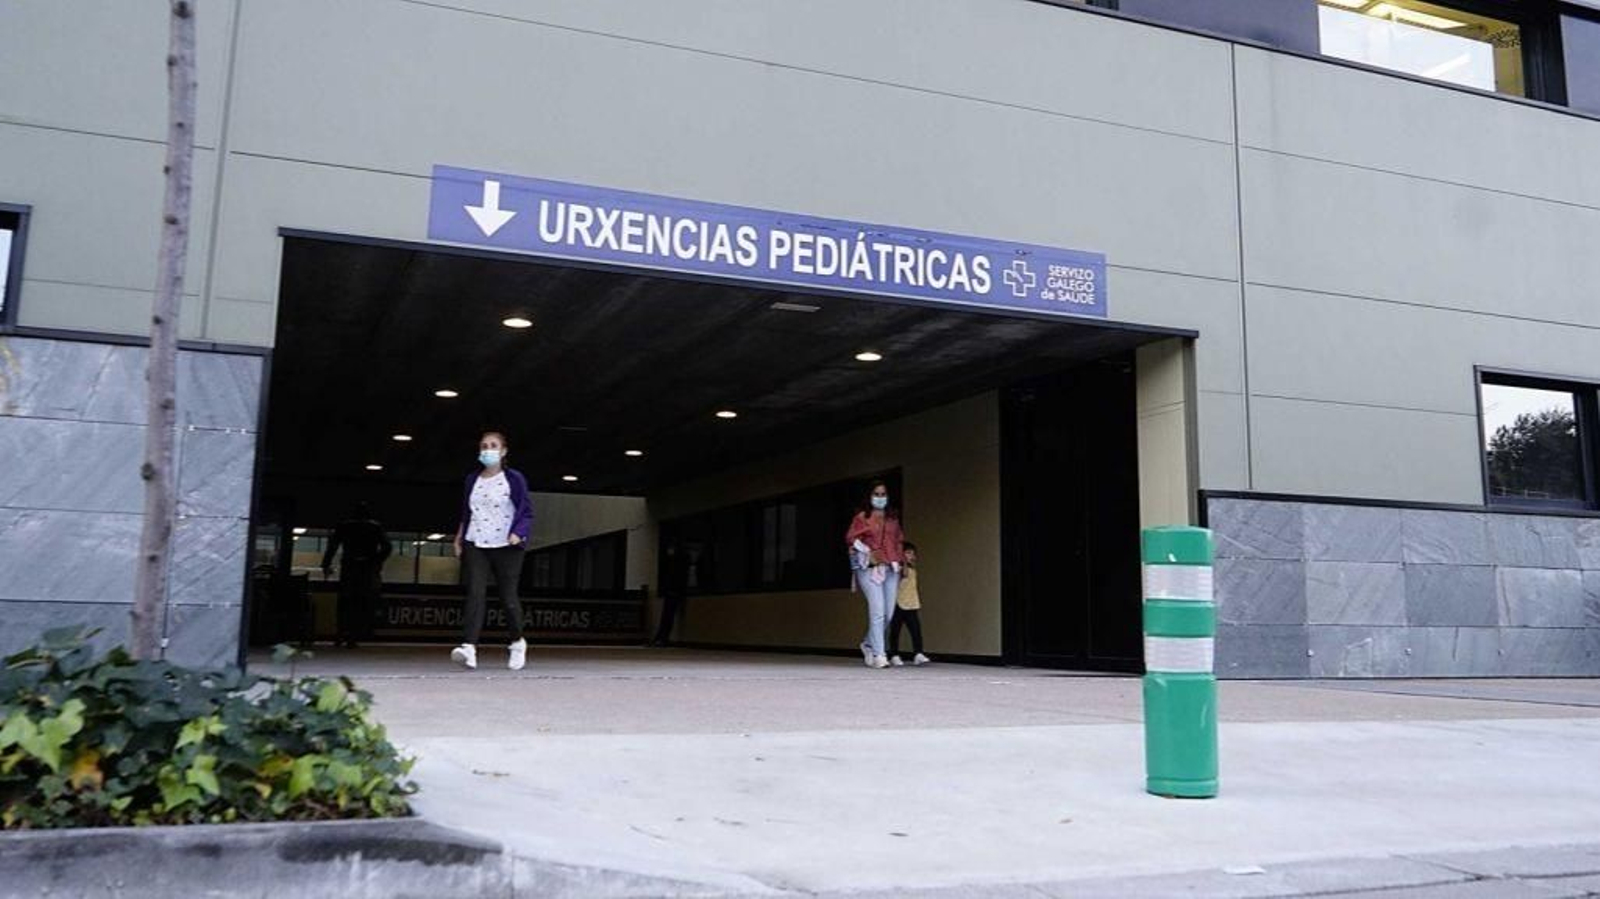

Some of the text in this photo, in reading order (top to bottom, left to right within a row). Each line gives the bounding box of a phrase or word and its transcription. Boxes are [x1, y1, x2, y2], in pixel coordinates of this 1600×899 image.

[538, 199, 992, 294] URXENCIAS PEDIÁTRICAS
[1048, 264, 1095, 281] SERVIZO
[1046, 277, 1095, 293] GALEGO
[1040, 288, 1055, 300] de
[388, 607, 479, 626] URXENCI
